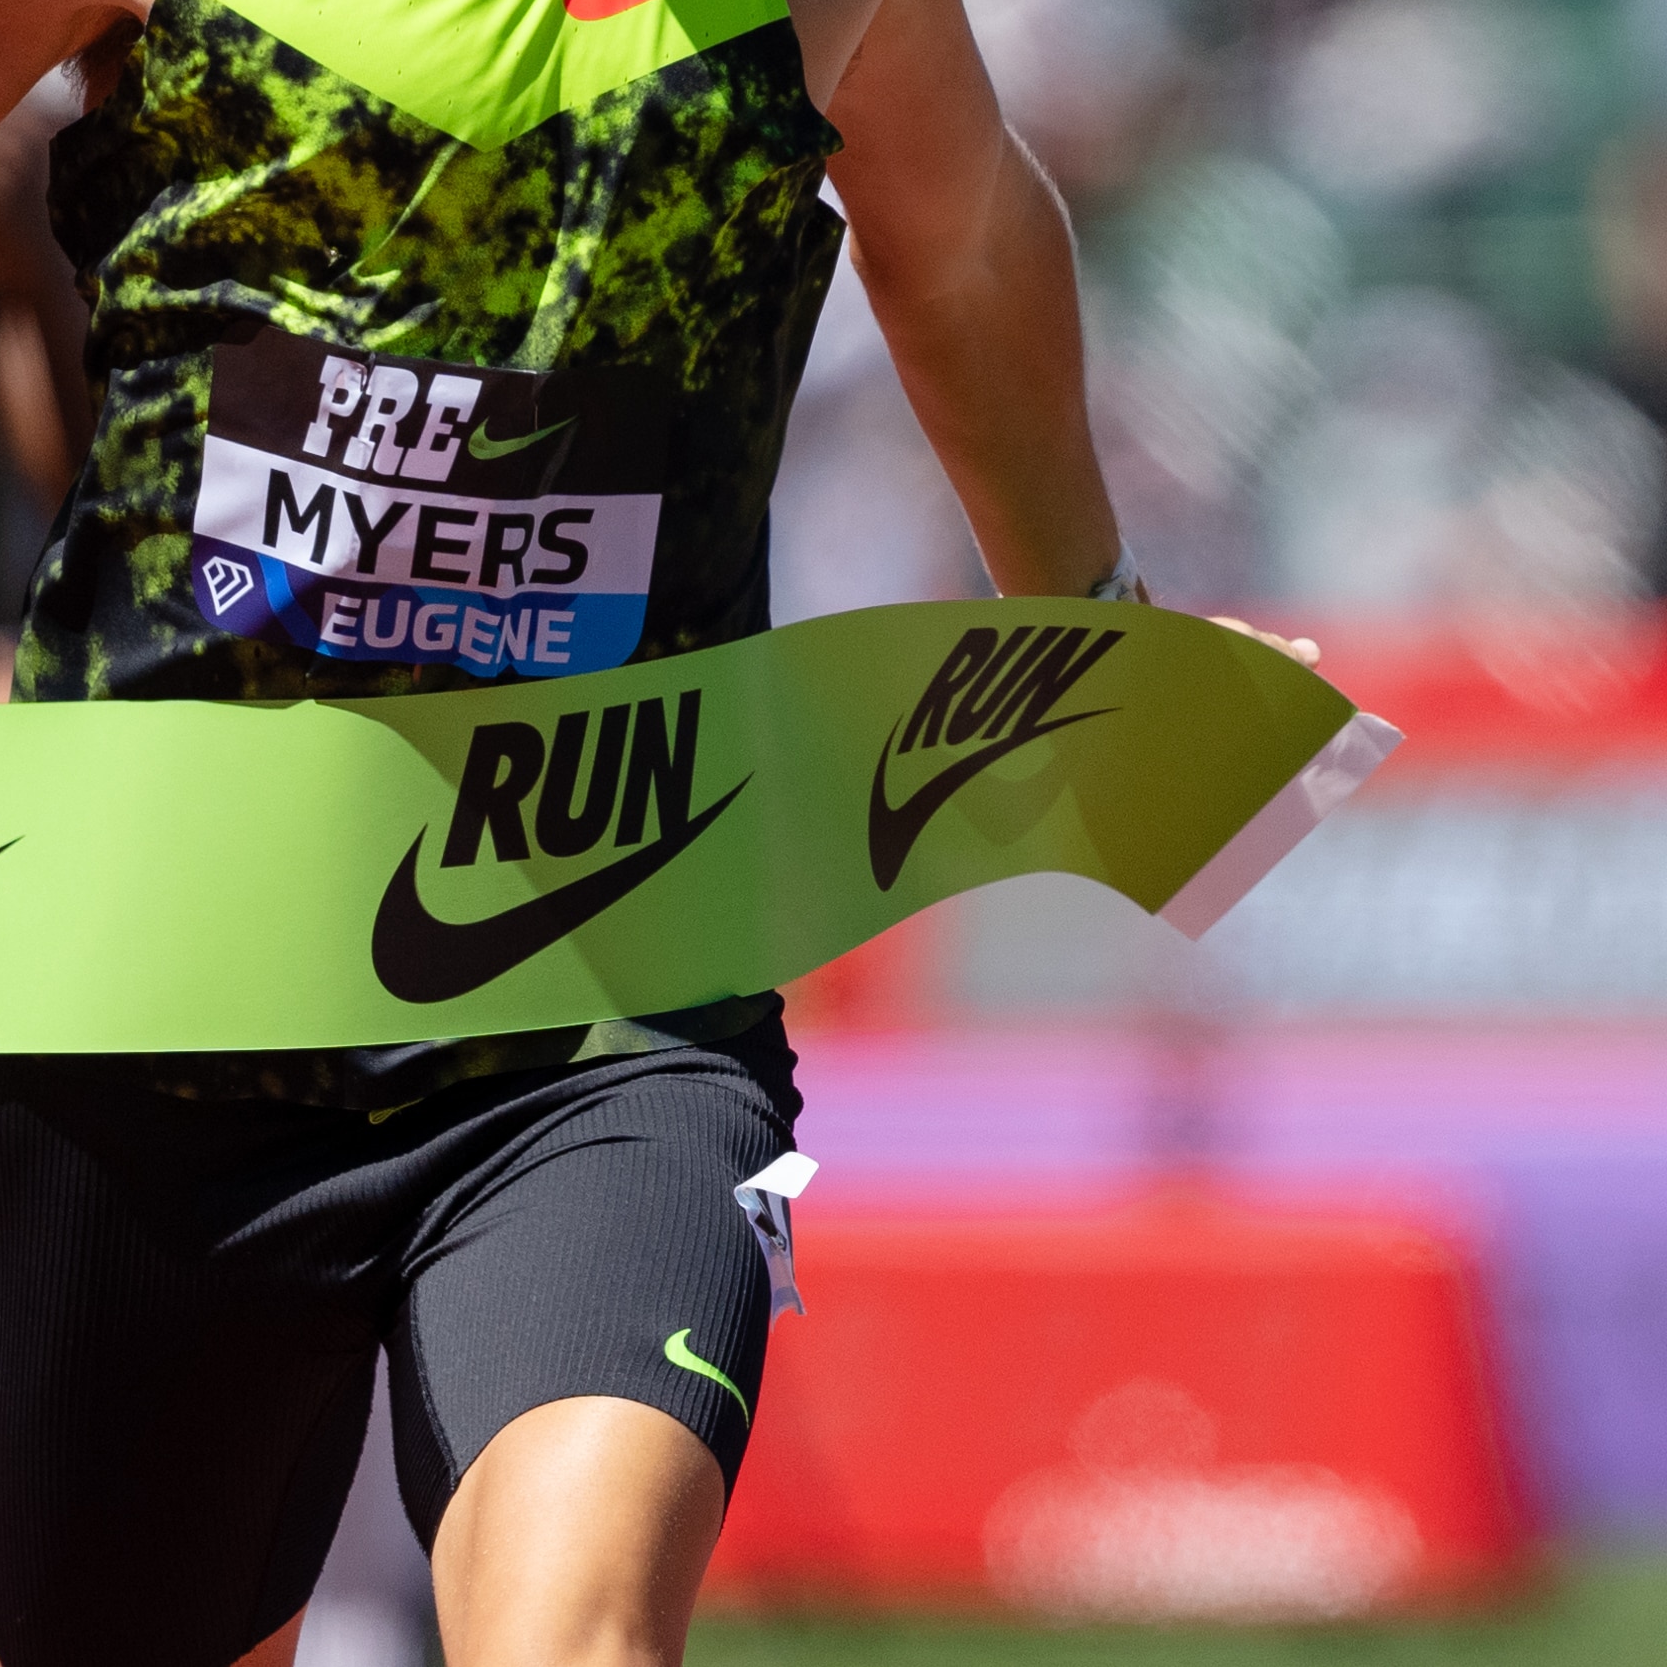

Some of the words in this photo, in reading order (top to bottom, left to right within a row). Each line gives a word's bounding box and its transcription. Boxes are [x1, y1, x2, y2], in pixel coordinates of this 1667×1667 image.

[302, 355, 483, 482] PRE
[263, 468, 595, 588] MYERS
[320, 592, 575, 664] EUGENE
[897, 626, 1126, 754] RUN
[440, 689, 702, 869] RUN
